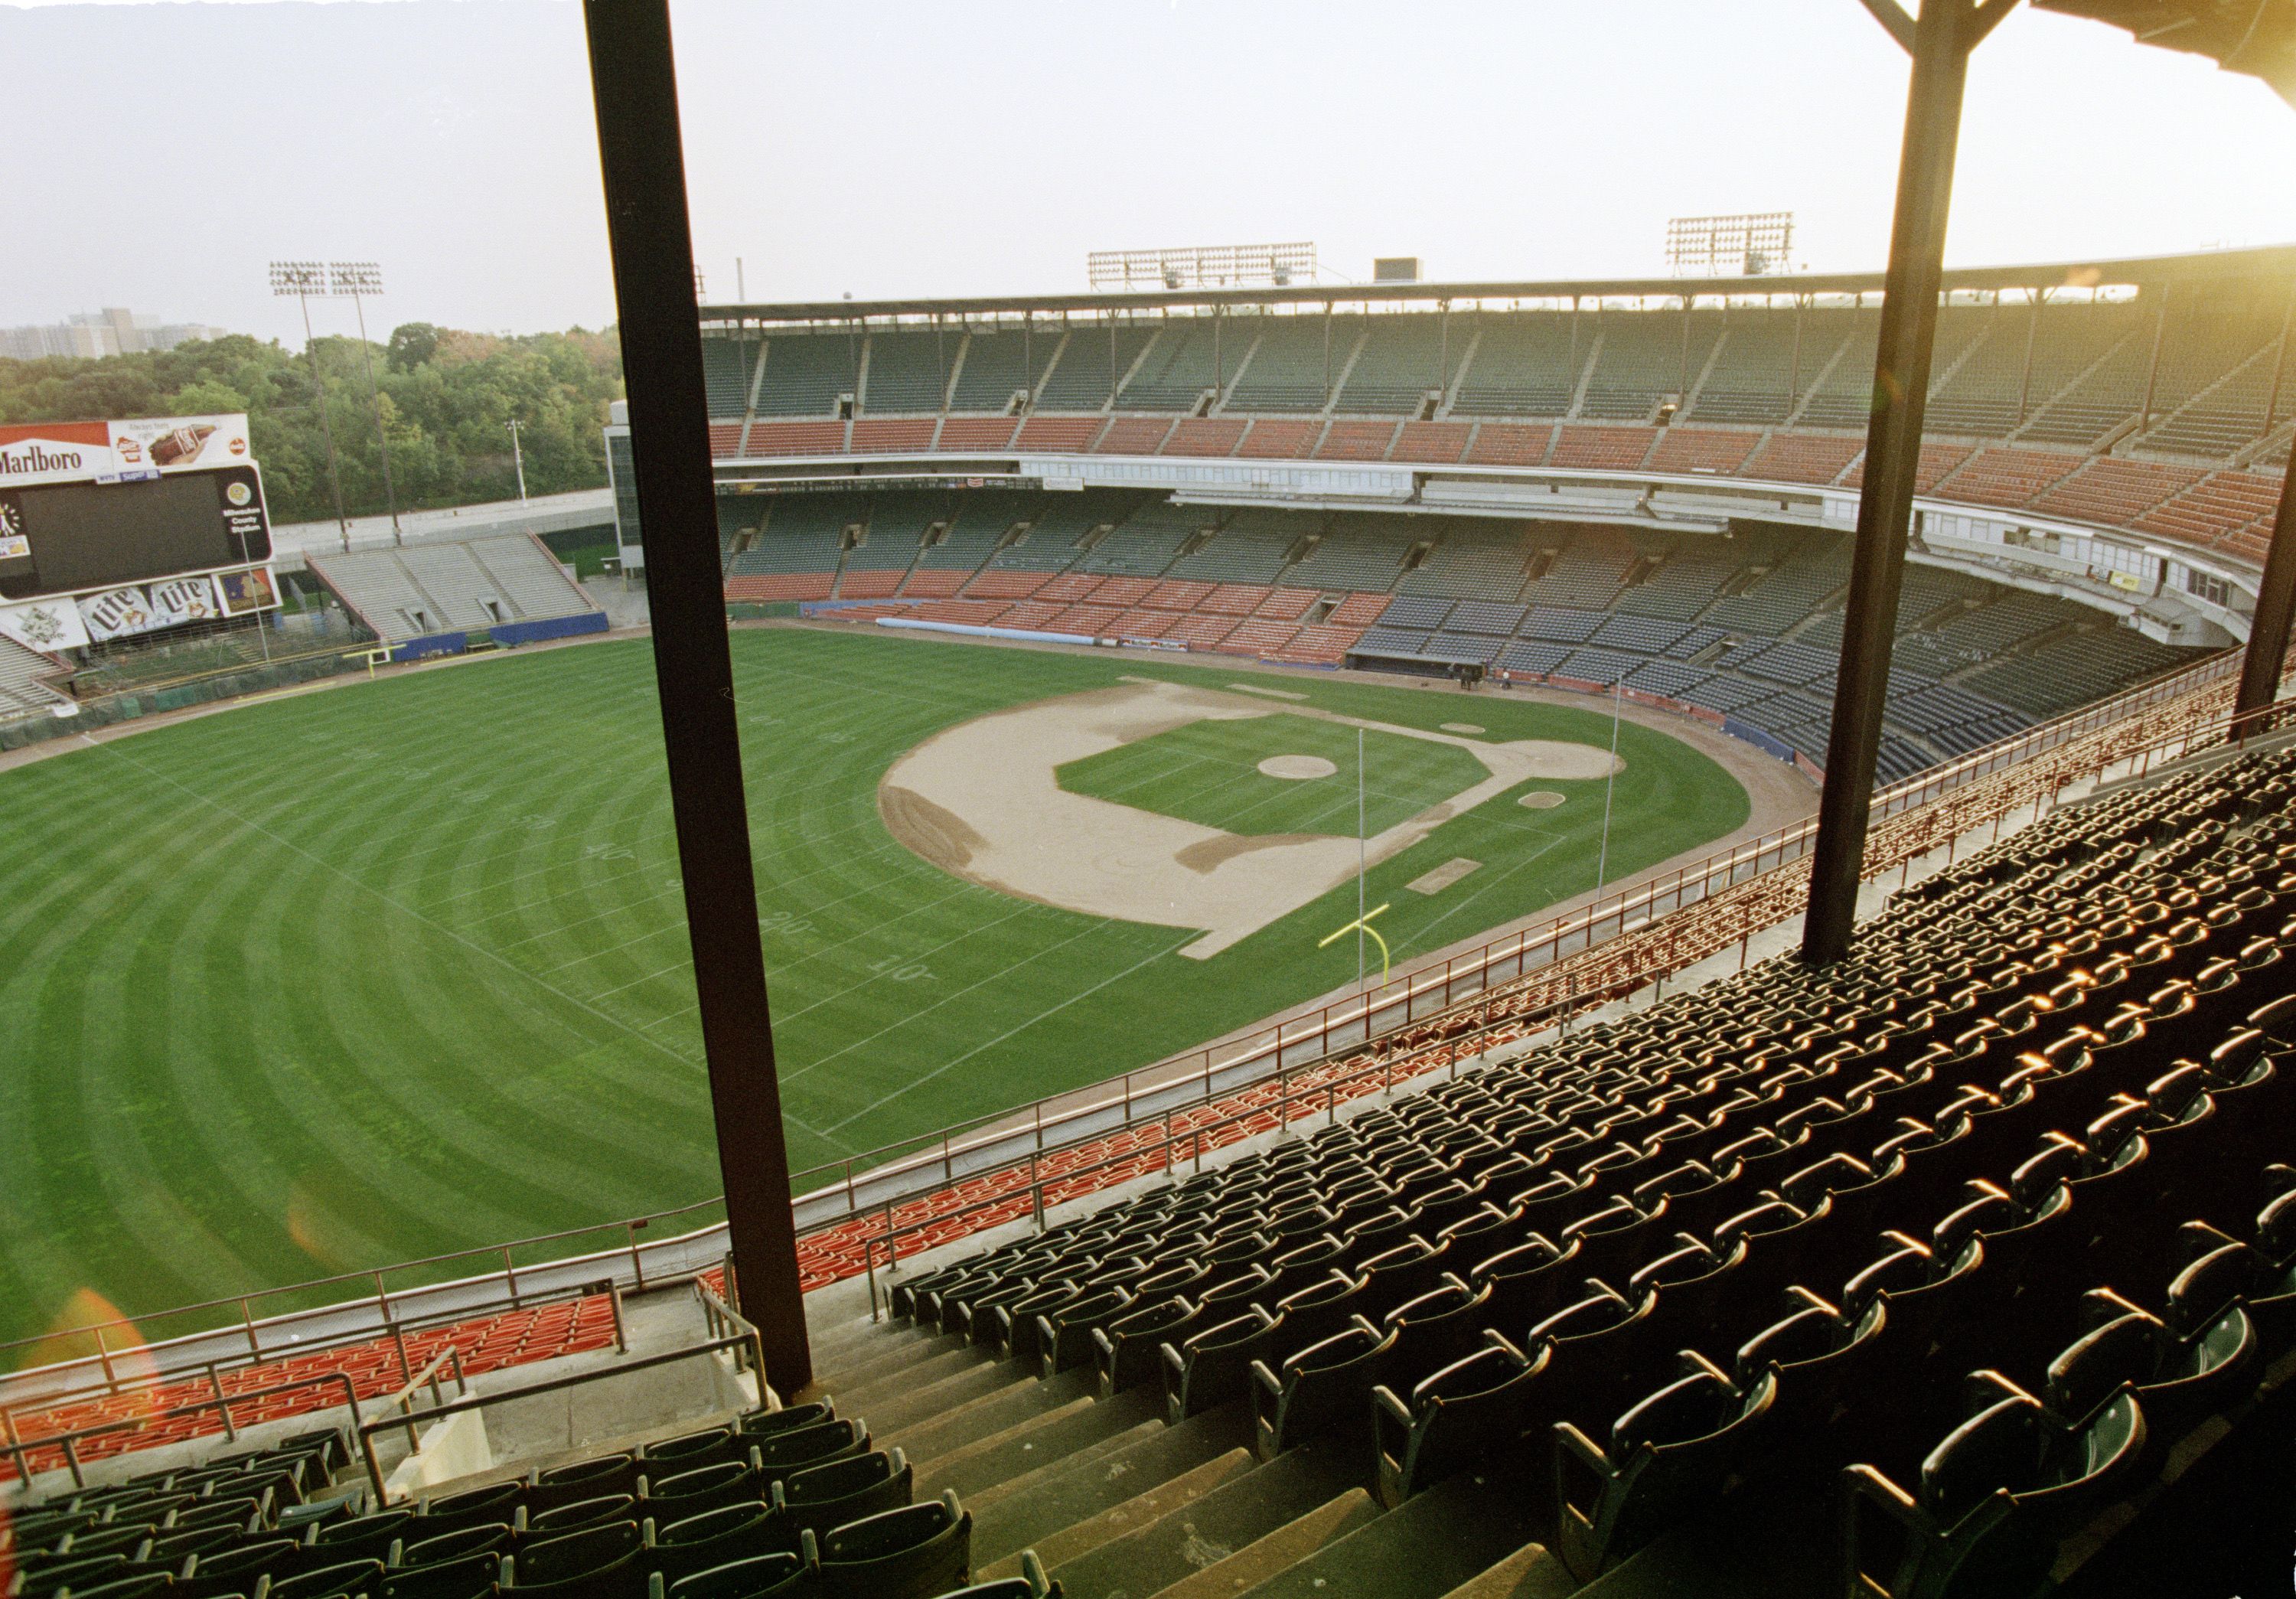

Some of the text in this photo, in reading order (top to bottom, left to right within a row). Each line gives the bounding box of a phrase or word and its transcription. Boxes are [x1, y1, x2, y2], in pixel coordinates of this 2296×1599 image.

[91, 590, 135, 631] Lite
[158, 580, 204, 613] Lite
[866, 955, 929, 982] 10
